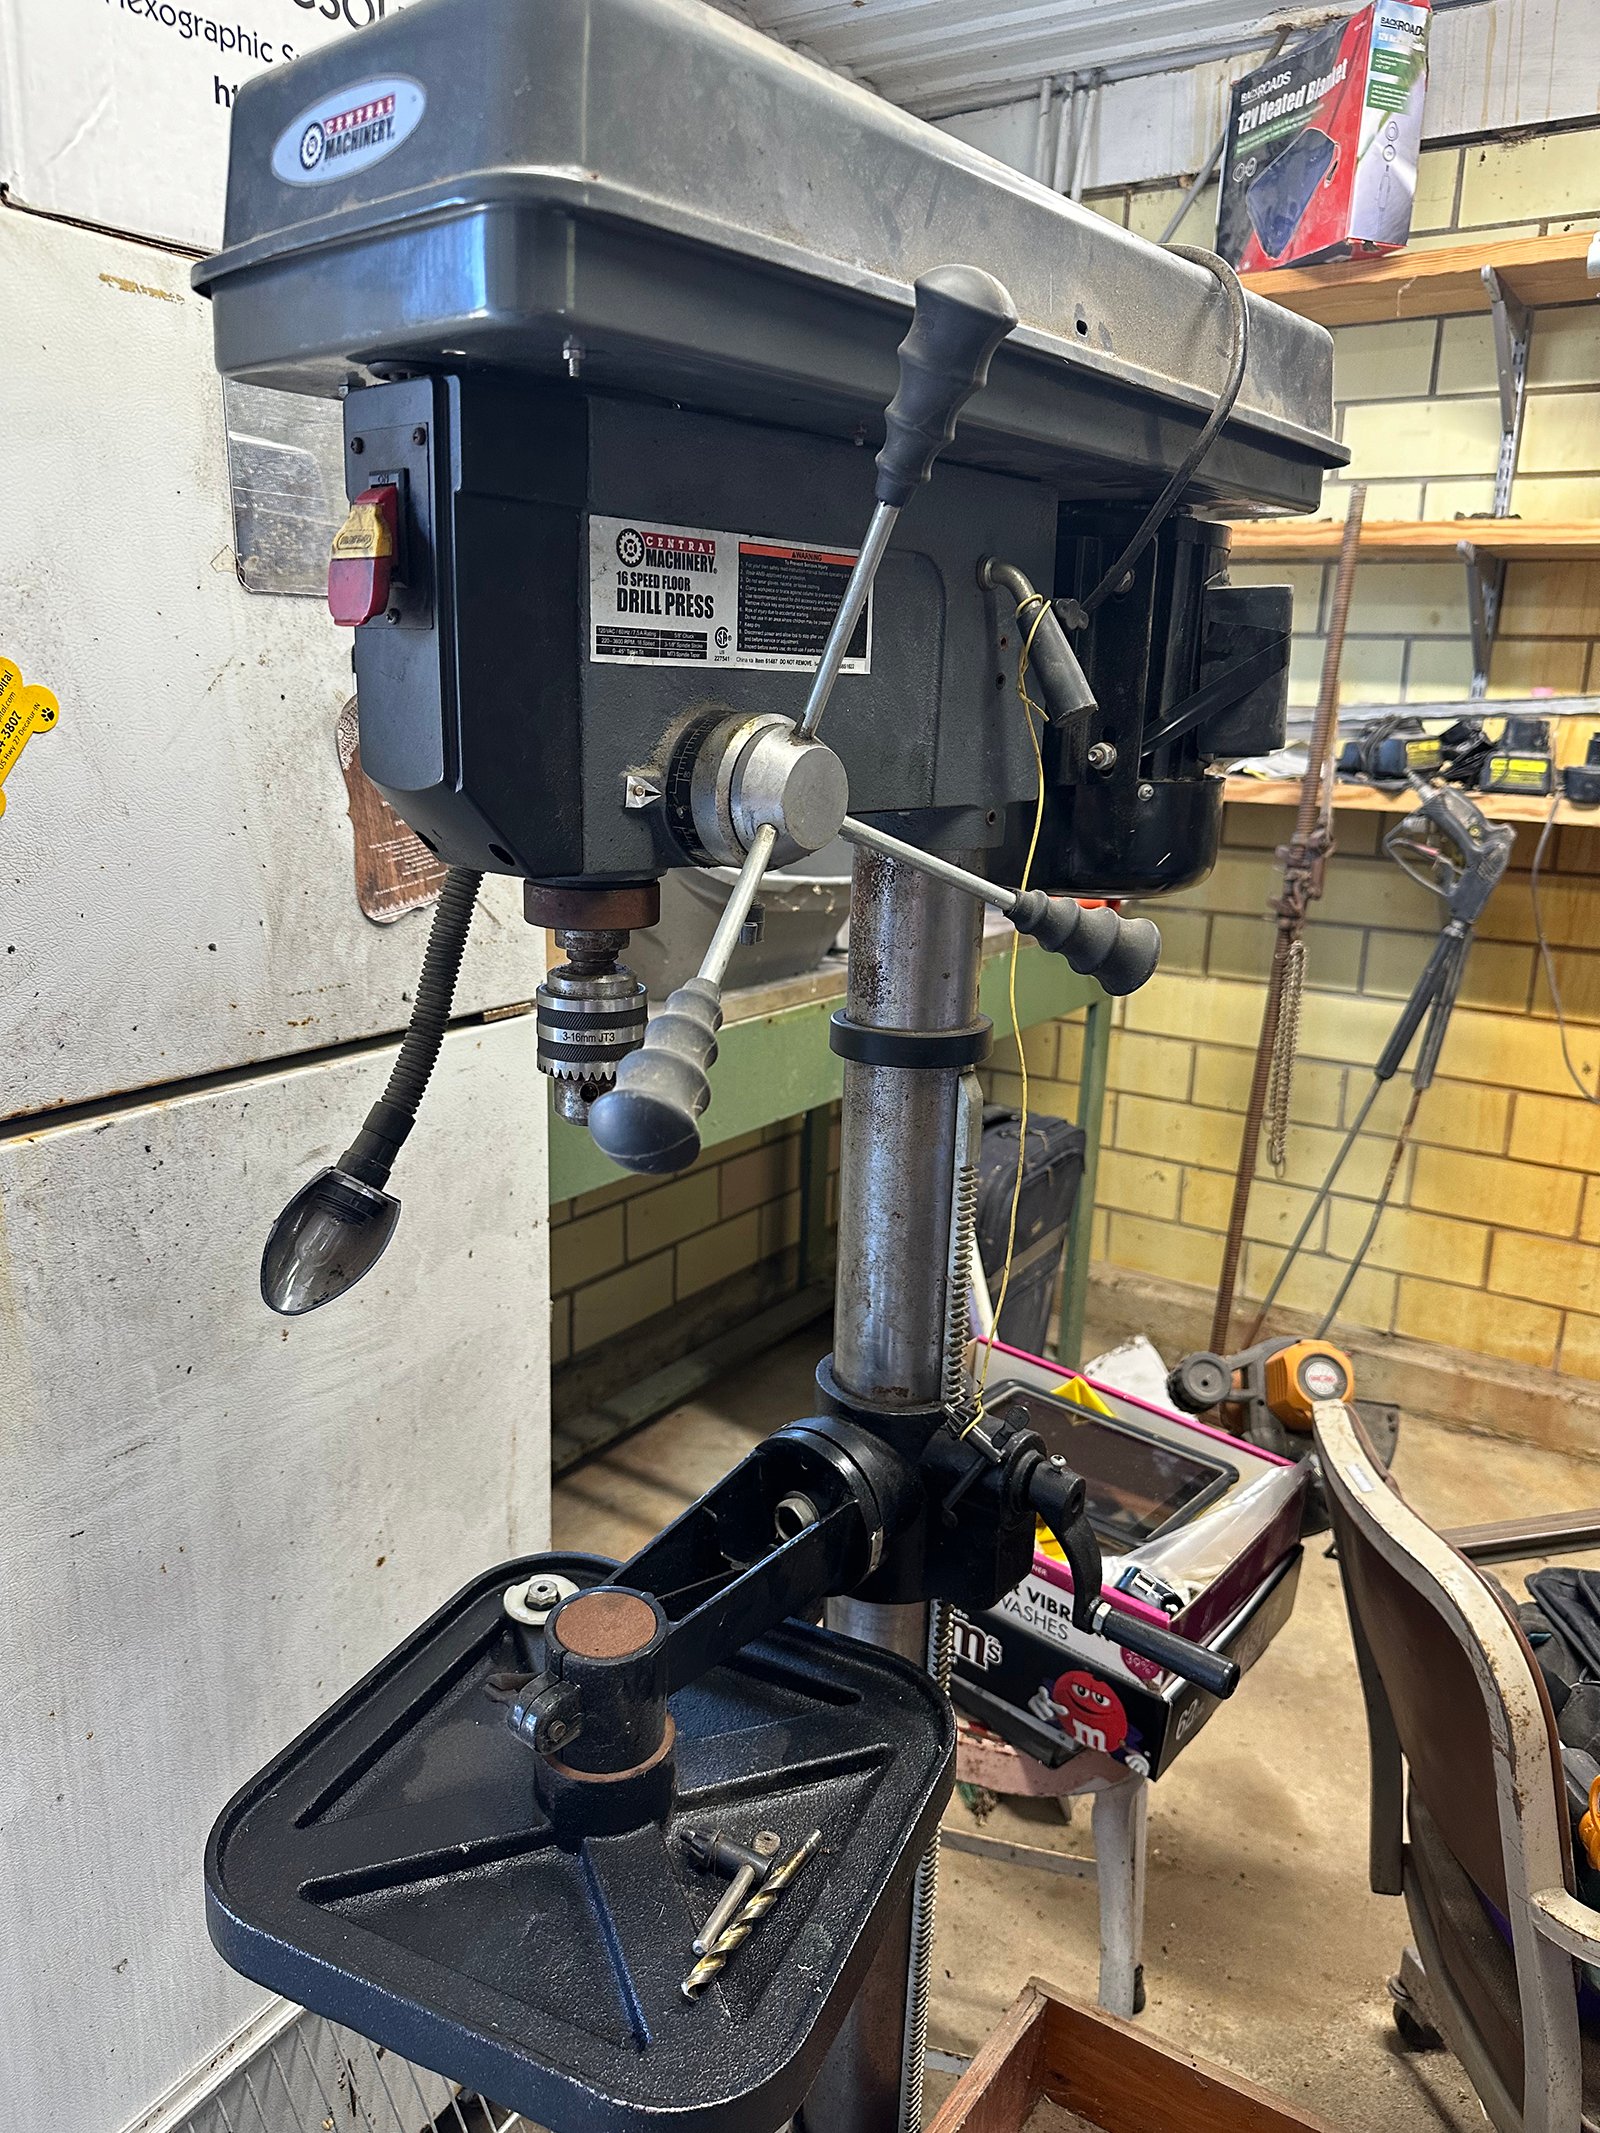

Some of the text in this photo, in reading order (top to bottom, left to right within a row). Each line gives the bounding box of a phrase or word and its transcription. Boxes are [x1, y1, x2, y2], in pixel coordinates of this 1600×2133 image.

[106, 0, 273, 62] exographic
[1238, 105, 1260, 135] 12V
[1258, 84, 1307, 125] Heated
[1305, 58, 1348, 105] Blanket
[1240, 70, 1292, 104] BACKROADS
[646, 536, 715, 554] CENTRAL
[616, 570, 691, 593] 16 SPEED FLOOR
[617, 587, 715, 620] DRILL PRESS
[4, 745, 17, 761] Hwy
[13, 735, 21, 746] 27
[562, 1031, 616, 1042] 3-16mm JT3
